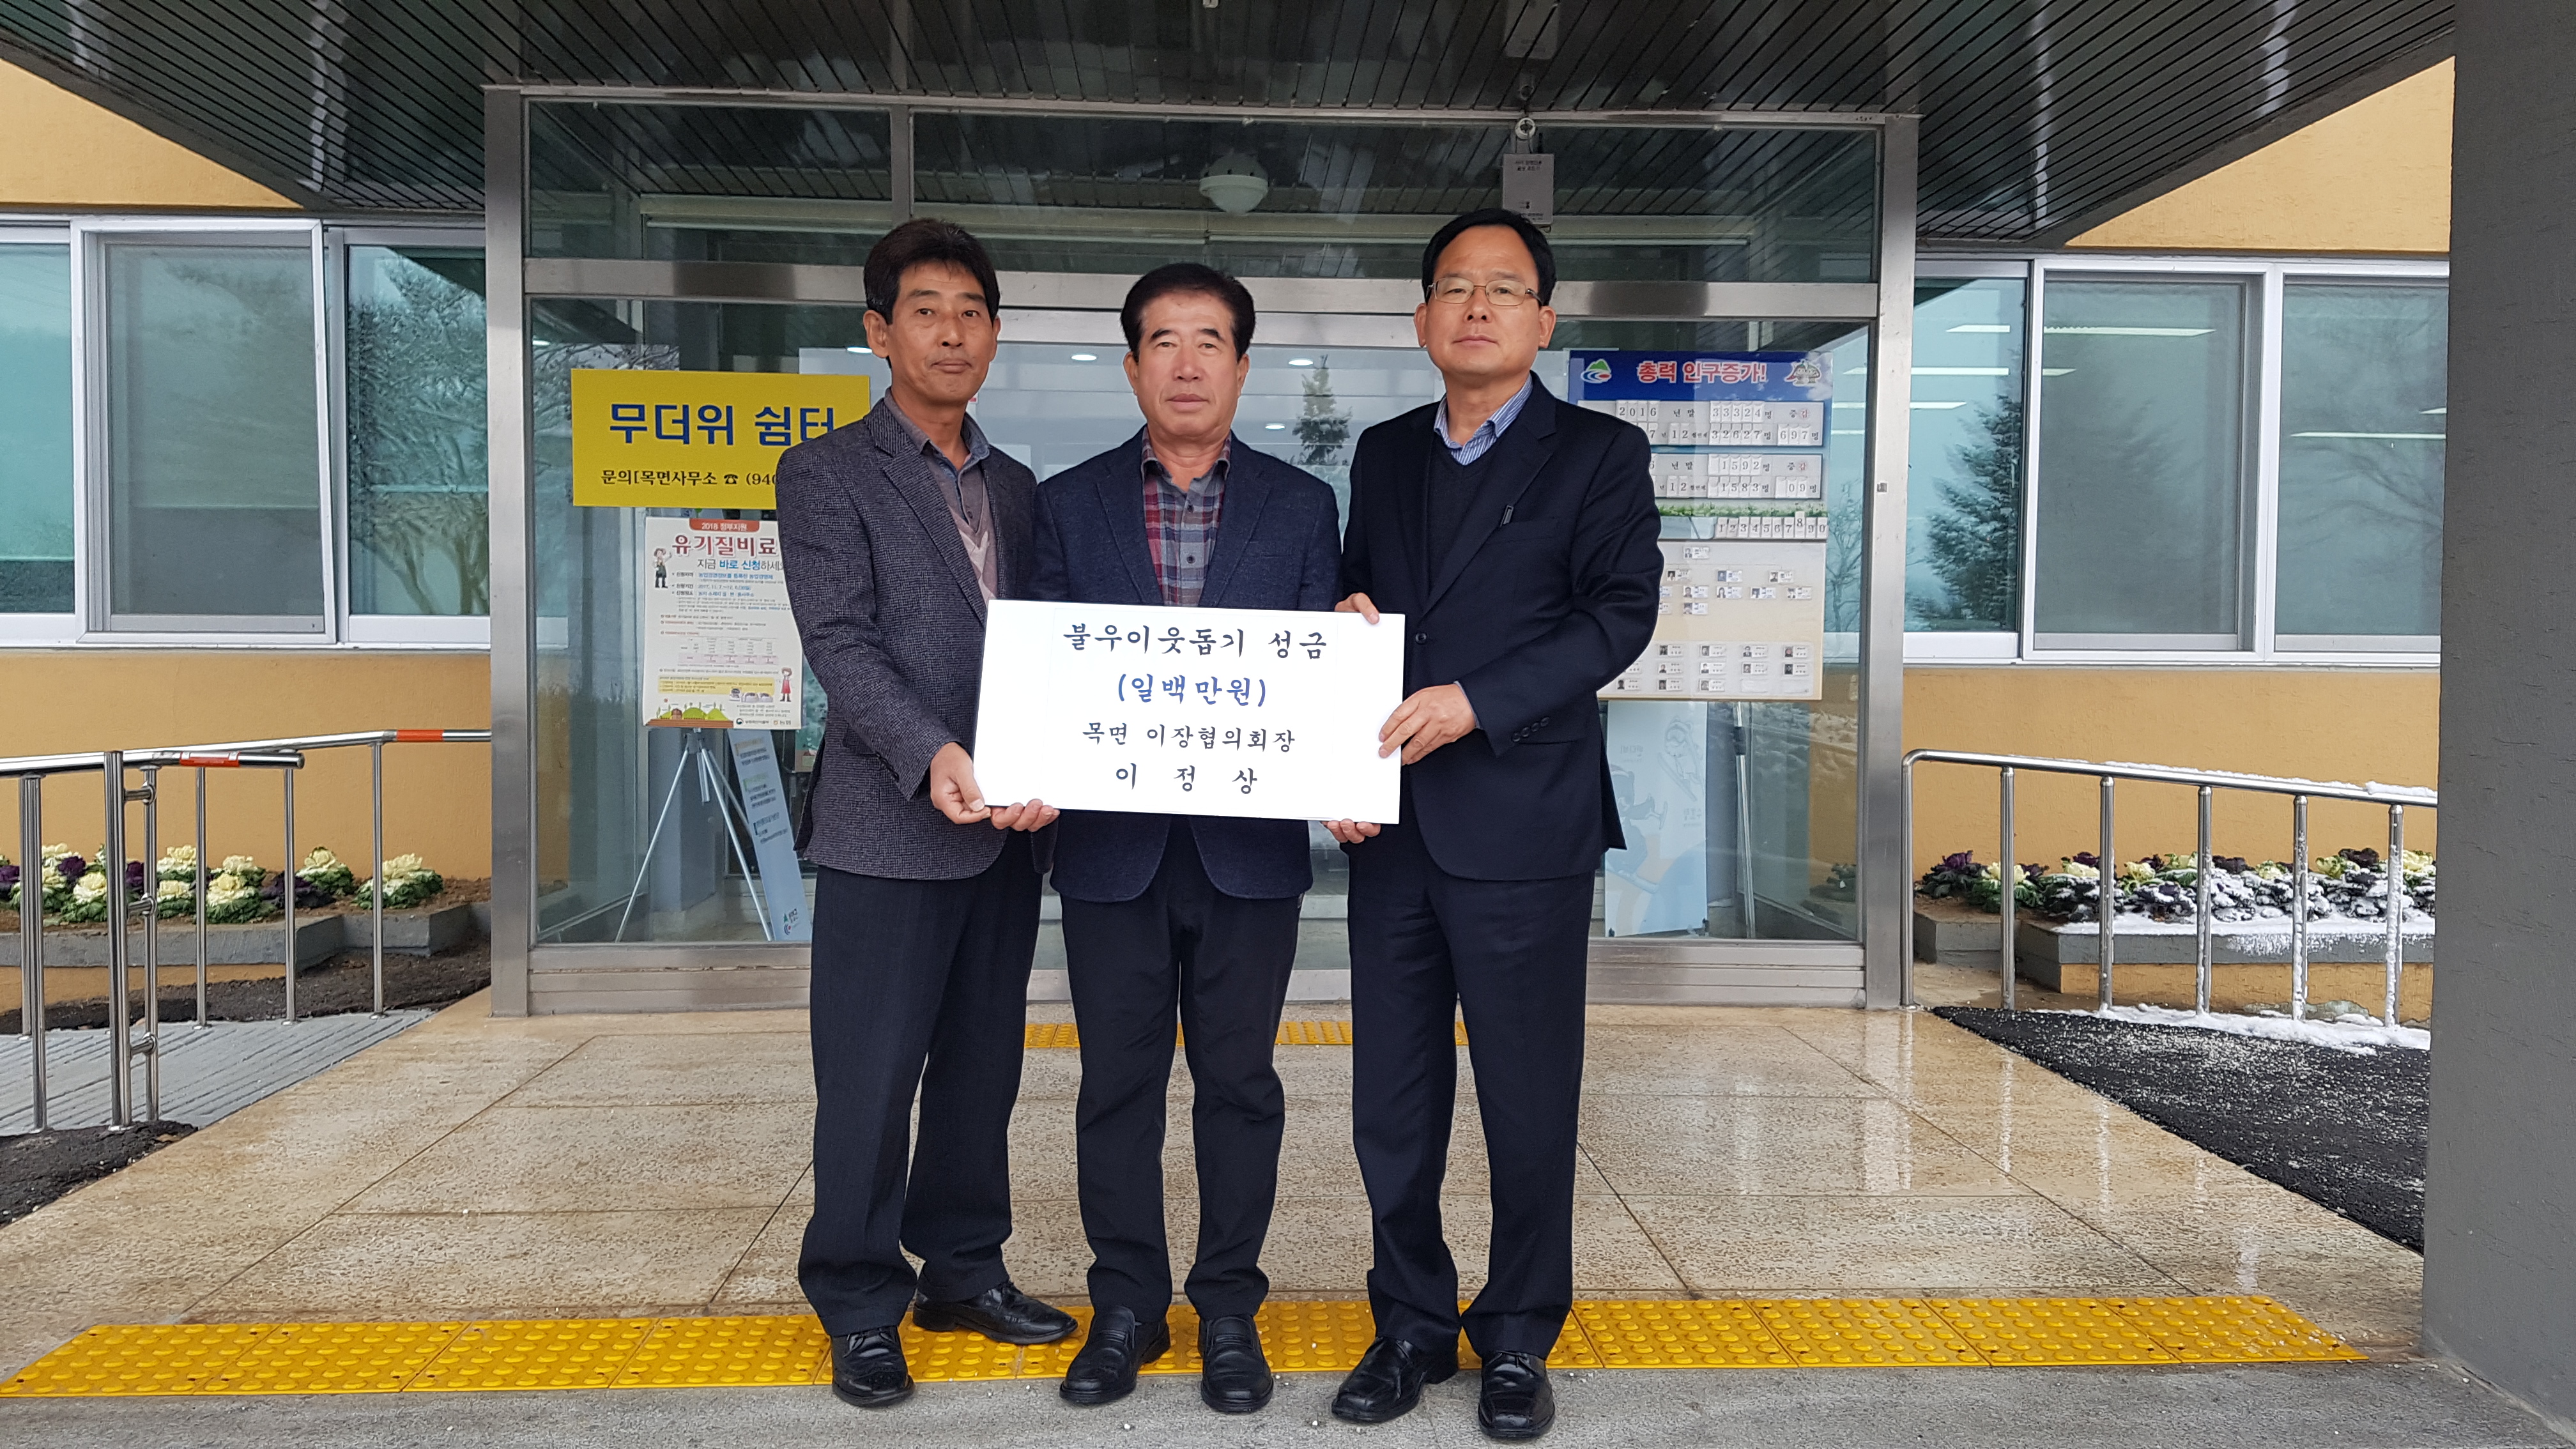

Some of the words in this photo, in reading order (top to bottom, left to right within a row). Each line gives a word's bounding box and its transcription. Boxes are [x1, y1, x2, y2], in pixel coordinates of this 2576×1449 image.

[1639, 362, 1676, 382] 총력
[1683, 362, 1767, 383] 인구증가!
[1619, 407, 1656, 417] 2016
[610, 403, 734, 446] 무더위
[754, 406, 835, 447] 쉼터
[601, 470, 717, 487] 문의[목면사무소
[720, 523, 747, 532] 정부지원
[672, 535, 776, 556] 유기질비료
[697, 559, 716, 569] 지금
[719, 560, 739, 570] 바로
[1064, 624, 1243, 657] 불우이웃돕기
[1269, 631, 1326, 659] 성금
[1119, 674, 1265, 707] (일백만원)
[1083, 723, 1126, 745] 목면
[1147, 724, 1294, 752] 이장협의회장
